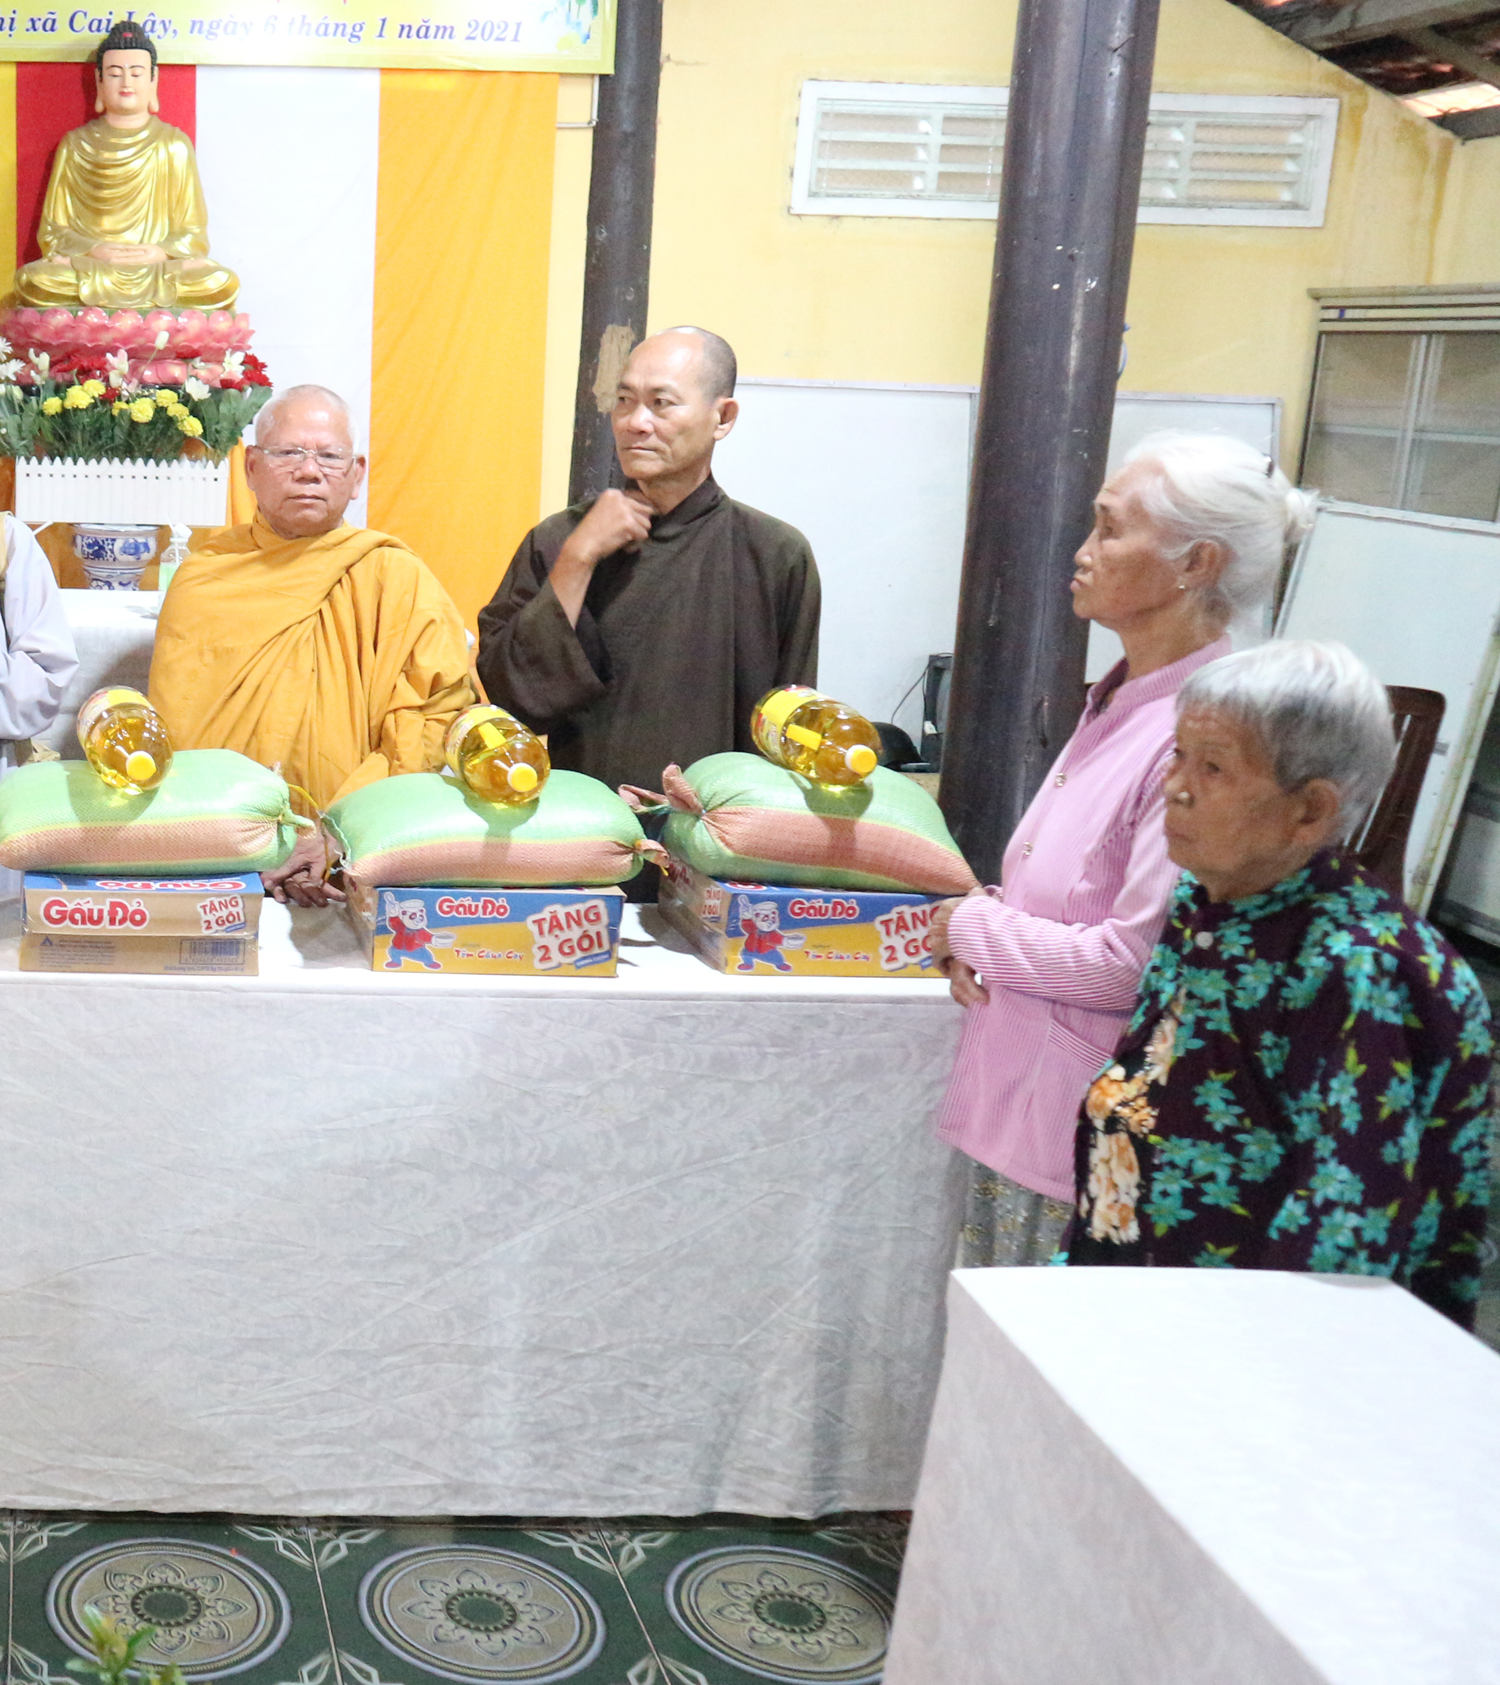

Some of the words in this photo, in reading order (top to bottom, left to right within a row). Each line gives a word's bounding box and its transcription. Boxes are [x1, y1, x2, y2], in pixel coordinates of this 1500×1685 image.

[25, 11, 58, 32] xã
[68, 10, 114, 33] Cai
[189, 14, 253, 41] ngày
[263, 15, 278, 35] 6
[286, 15, 366, 43] tháng
[374, 17, 388, 39] 1
[397, 18, 456, 40] năm
[464, 19, 523, 42] 2021
[200, 896, 239, 917] TẶNG
[203, 920, 213, 931] 2
[215, 910, 242, 928] GÓI
[532, 904, 602, 938] TẶNG
[537, 944, 553, 963] 2
[558, 930, 604, 957] GÓI
[884, 944, 899, 963] 2
